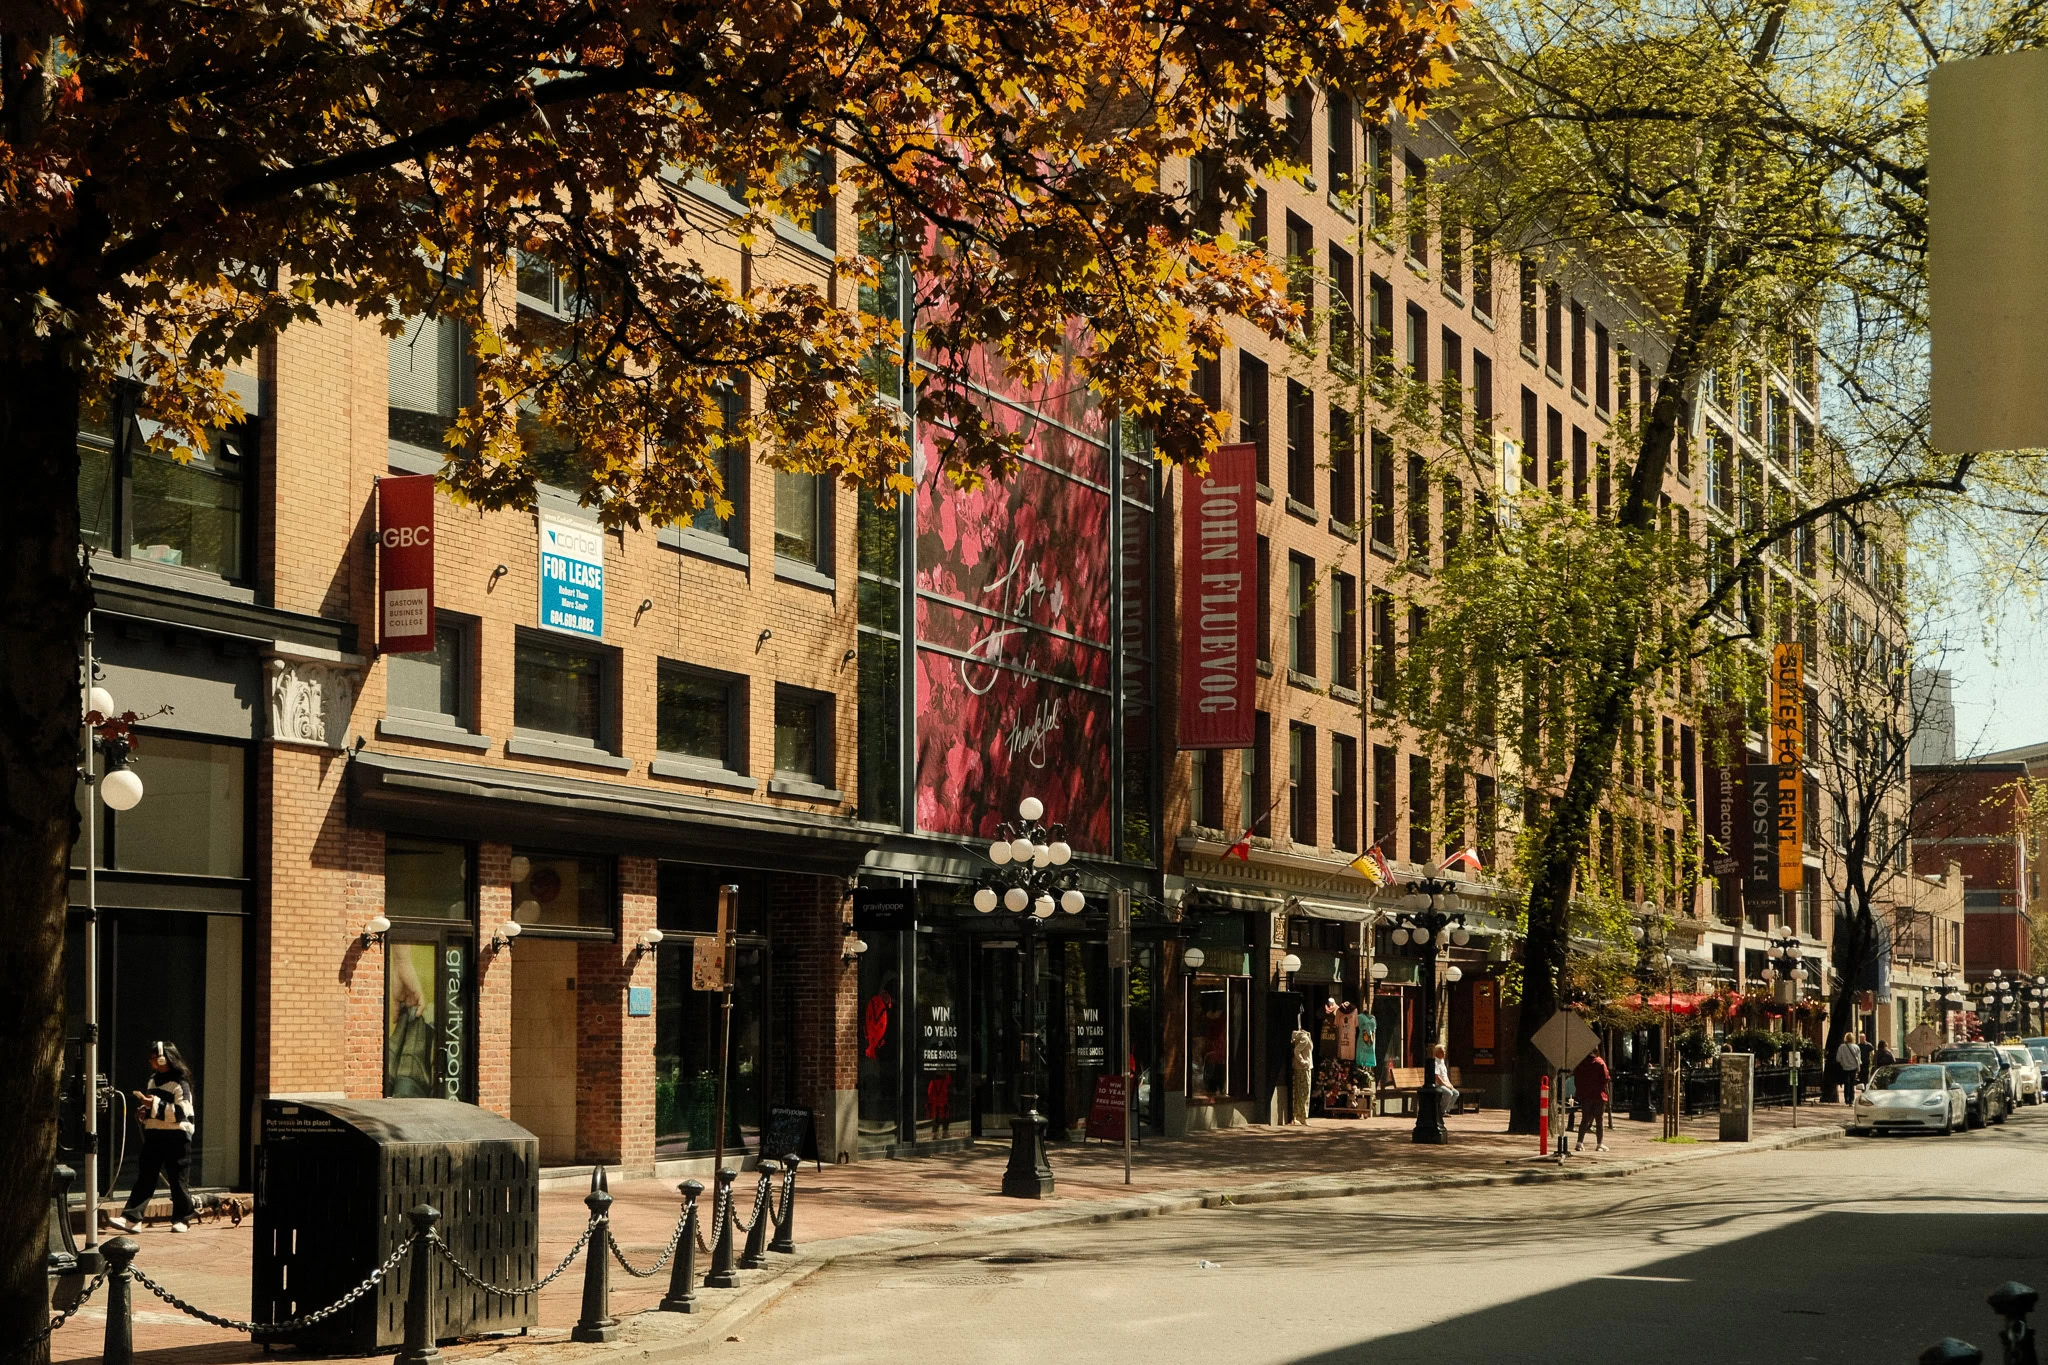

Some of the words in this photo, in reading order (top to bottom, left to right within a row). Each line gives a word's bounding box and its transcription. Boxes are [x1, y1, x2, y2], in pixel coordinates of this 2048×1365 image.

[1200, 478, 1241, 560] JOHN
[383, 526, 430, 548] GBC
[557, 533, 598, 557] corbel
[543, 555, 567, 581] FOR
[569, 561, 602, 590] LEASE
[389, 599, 423, 608] GASTOWN
[389, 609, 423, 617] BUSINESS
[389, 618, 423, 627] COLLEGE
[1199, 571, 1242, 713] FLUEVOG
[1778, 738, 1797, 781] FOR
[1778, 788, 1797, 846] RENT
[1753, 781, 1769, 882] FILSON
[862, 902, 904, 912] gravitypope
[931, 1006, 951, 1021] WIN
[1083, 1008, 1099, 1022] WIN
[924, 1025, 933, 1037] 10
[934, 1026, 958, 1037] YEARS
[1077, 1026, 1085, 1036] 10
[1086, 1026, 1104, 1036] YEARS
[923, 1049, 938, 1060] FREE
[938, 1050, 957, 1060] SHOES
[1077, 1047, 1089, 1056] FREE
[1089, 1047, 1104, 1056] SHOES
